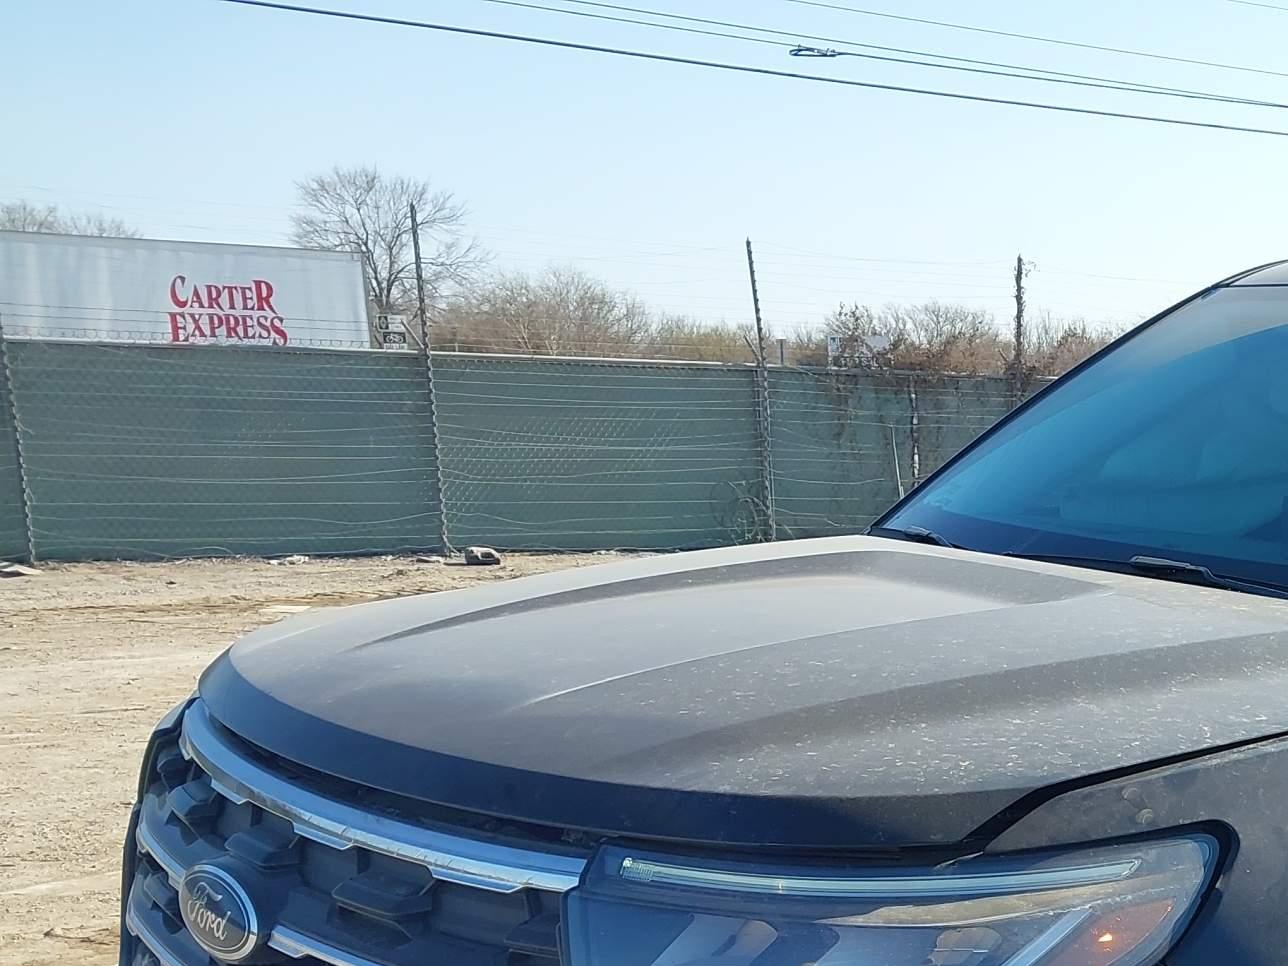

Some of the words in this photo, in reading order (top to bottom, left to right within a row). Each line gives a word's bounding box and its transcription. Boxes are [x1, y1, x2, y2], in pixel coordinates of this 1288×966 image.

[169, 274, 279, 315] CARTER
[167, 311, 289, 346] EXPRESS
[187, 881, 232, 941] Ford
